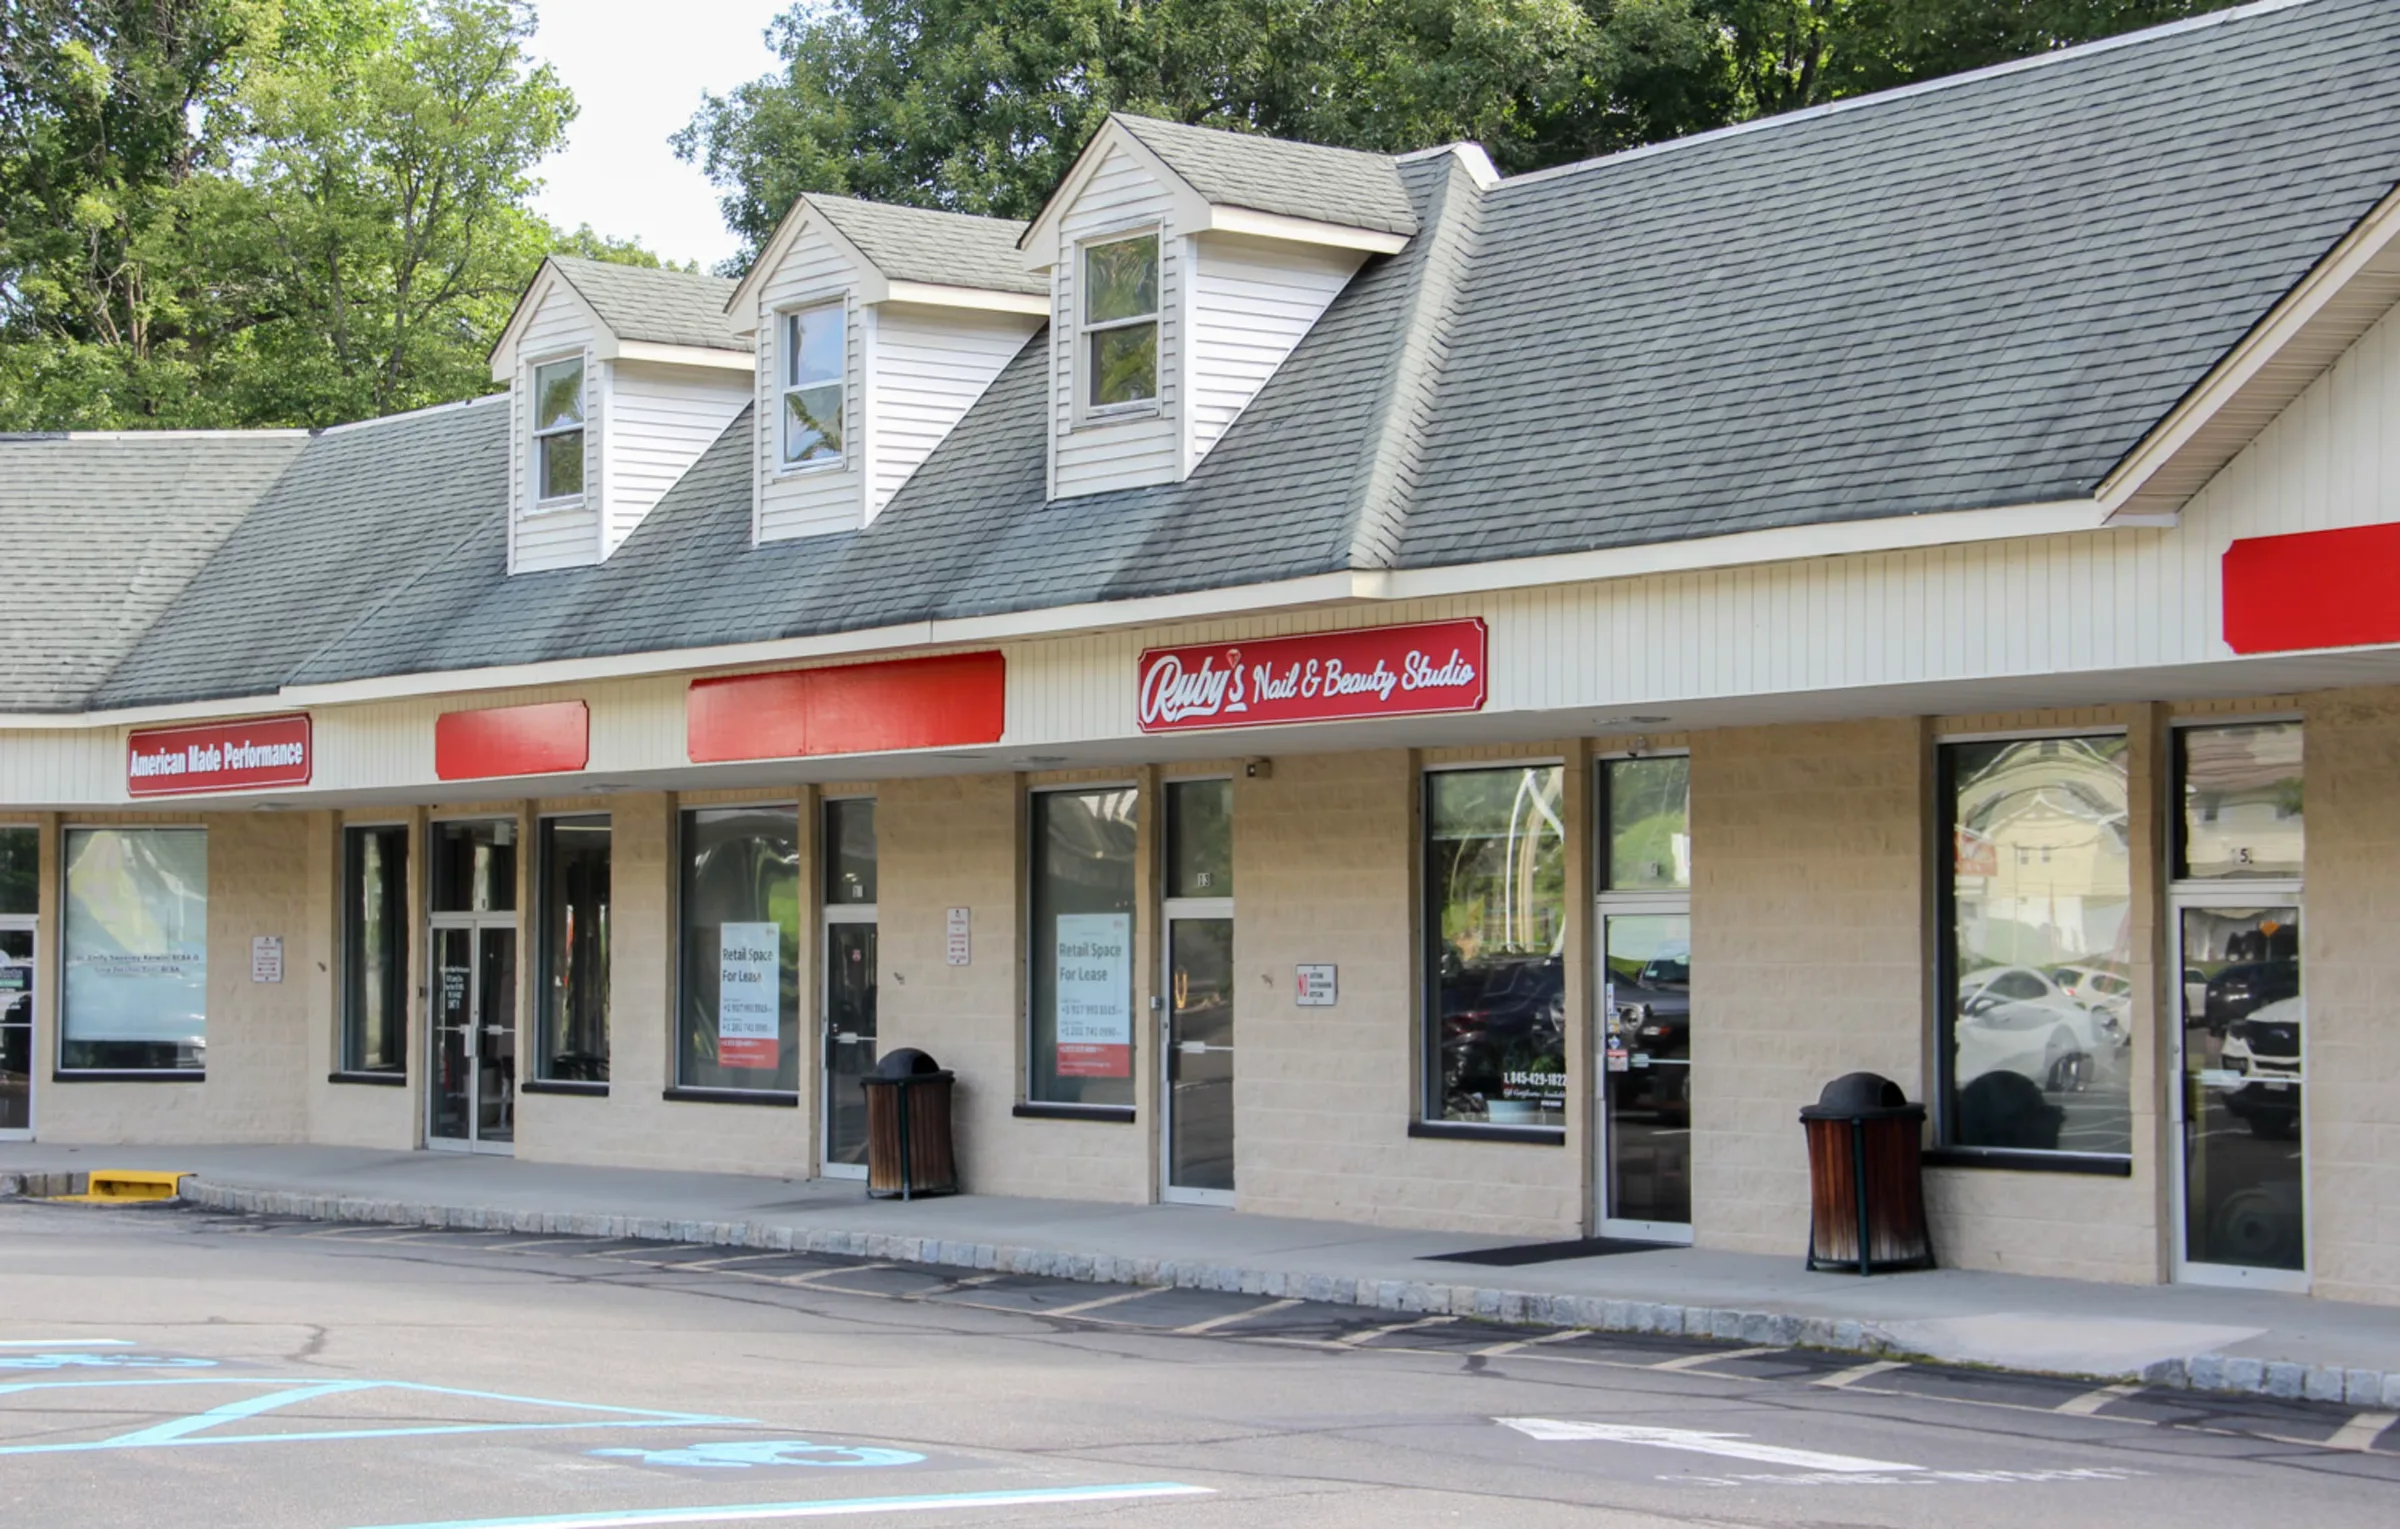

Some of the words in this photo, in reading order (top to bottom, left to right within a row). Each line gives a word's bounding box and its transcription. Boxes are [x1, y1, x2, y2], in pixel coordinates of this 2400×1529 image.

[1141, 653, 1248, 722] Ruby's
[1253, 661, 1300, 703] Nail
[1301, 659, 1322, 698] &
[1323, 658, 1396, 702] Beauty
[1402, 648, 1475, 691] Studio
[130, 747, 186, 777] American
[188, 743, 221, 773] Made
[224, 739, 303, 770] Performance
[723, 947, 747, 961] Retail
[748, 947, 773, 964] Space
[1059, 942, 1089, 957] Retail
[1091, 942, 1122, 960] Space
[723, 970, 737, 982] For
[738, 970, 762, 982] Lease
[1060, 967, 1076, 981] For
[1078, 967, 1108, 981] Lease
